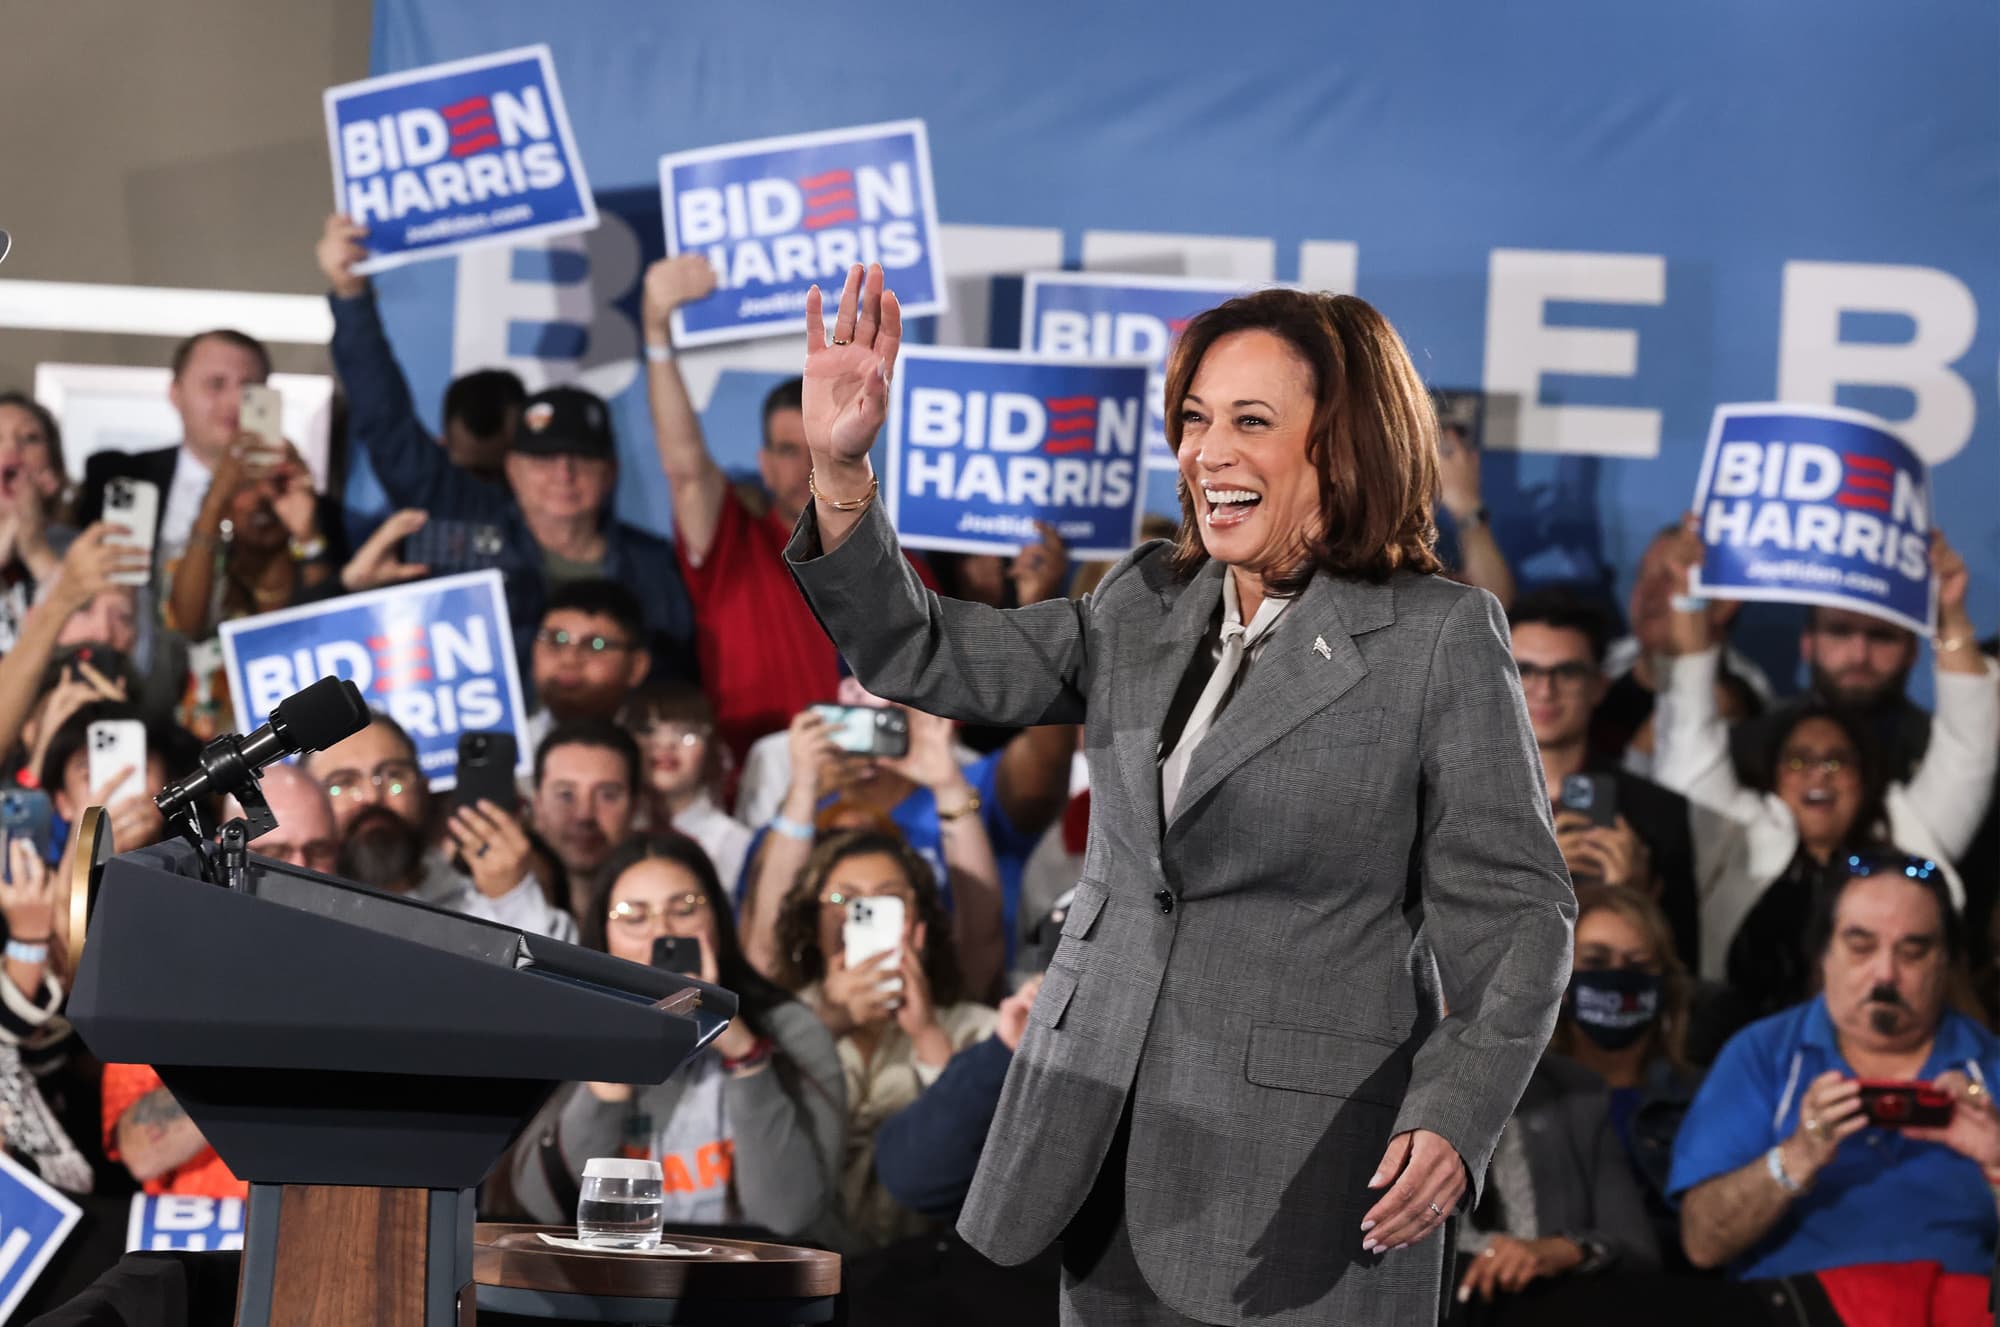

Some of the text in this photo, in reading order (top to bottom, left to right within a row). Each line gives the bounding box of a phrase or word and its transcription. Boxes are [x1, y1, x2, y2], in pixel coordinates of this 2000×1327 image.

[343, 85, 550, 178] BIDEN
[349, 141, 565, 226] HARRIS
[678, 162, 914, 246] BIDEN
[1041, 310, 1191, 362] BID
[908, 388, 1139, 456] BIDEN
[906, 450, 1133, 508] HARRIS
[1713, 441, 1928, 534] BIDEN
[1704, 499, 1927, 582] HARRIS
